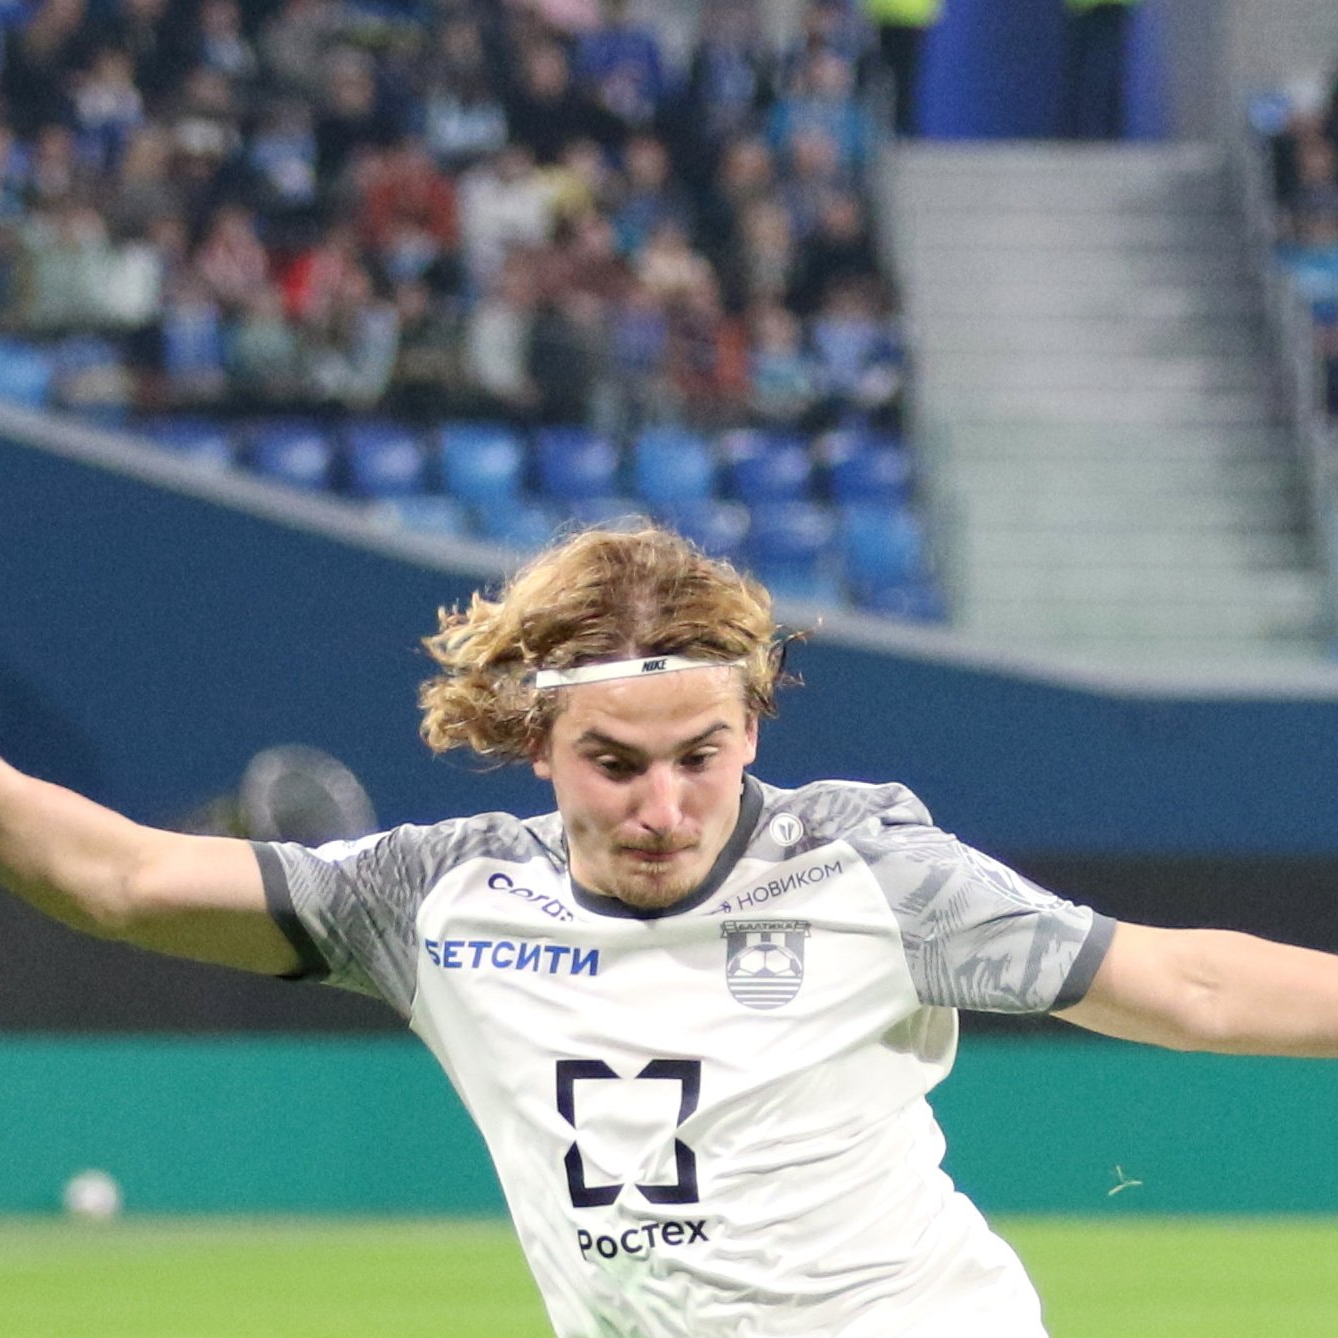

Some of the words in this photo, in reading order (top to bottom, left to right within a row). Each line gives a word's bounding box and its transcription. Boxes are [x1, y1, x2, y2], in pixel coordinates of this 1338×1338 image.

[737, 860, 843, 910] НОВИКОМ
[424, 938, 601, 977] БЕТСИТИ
[577, 1219, 710, 1262] Ростех
